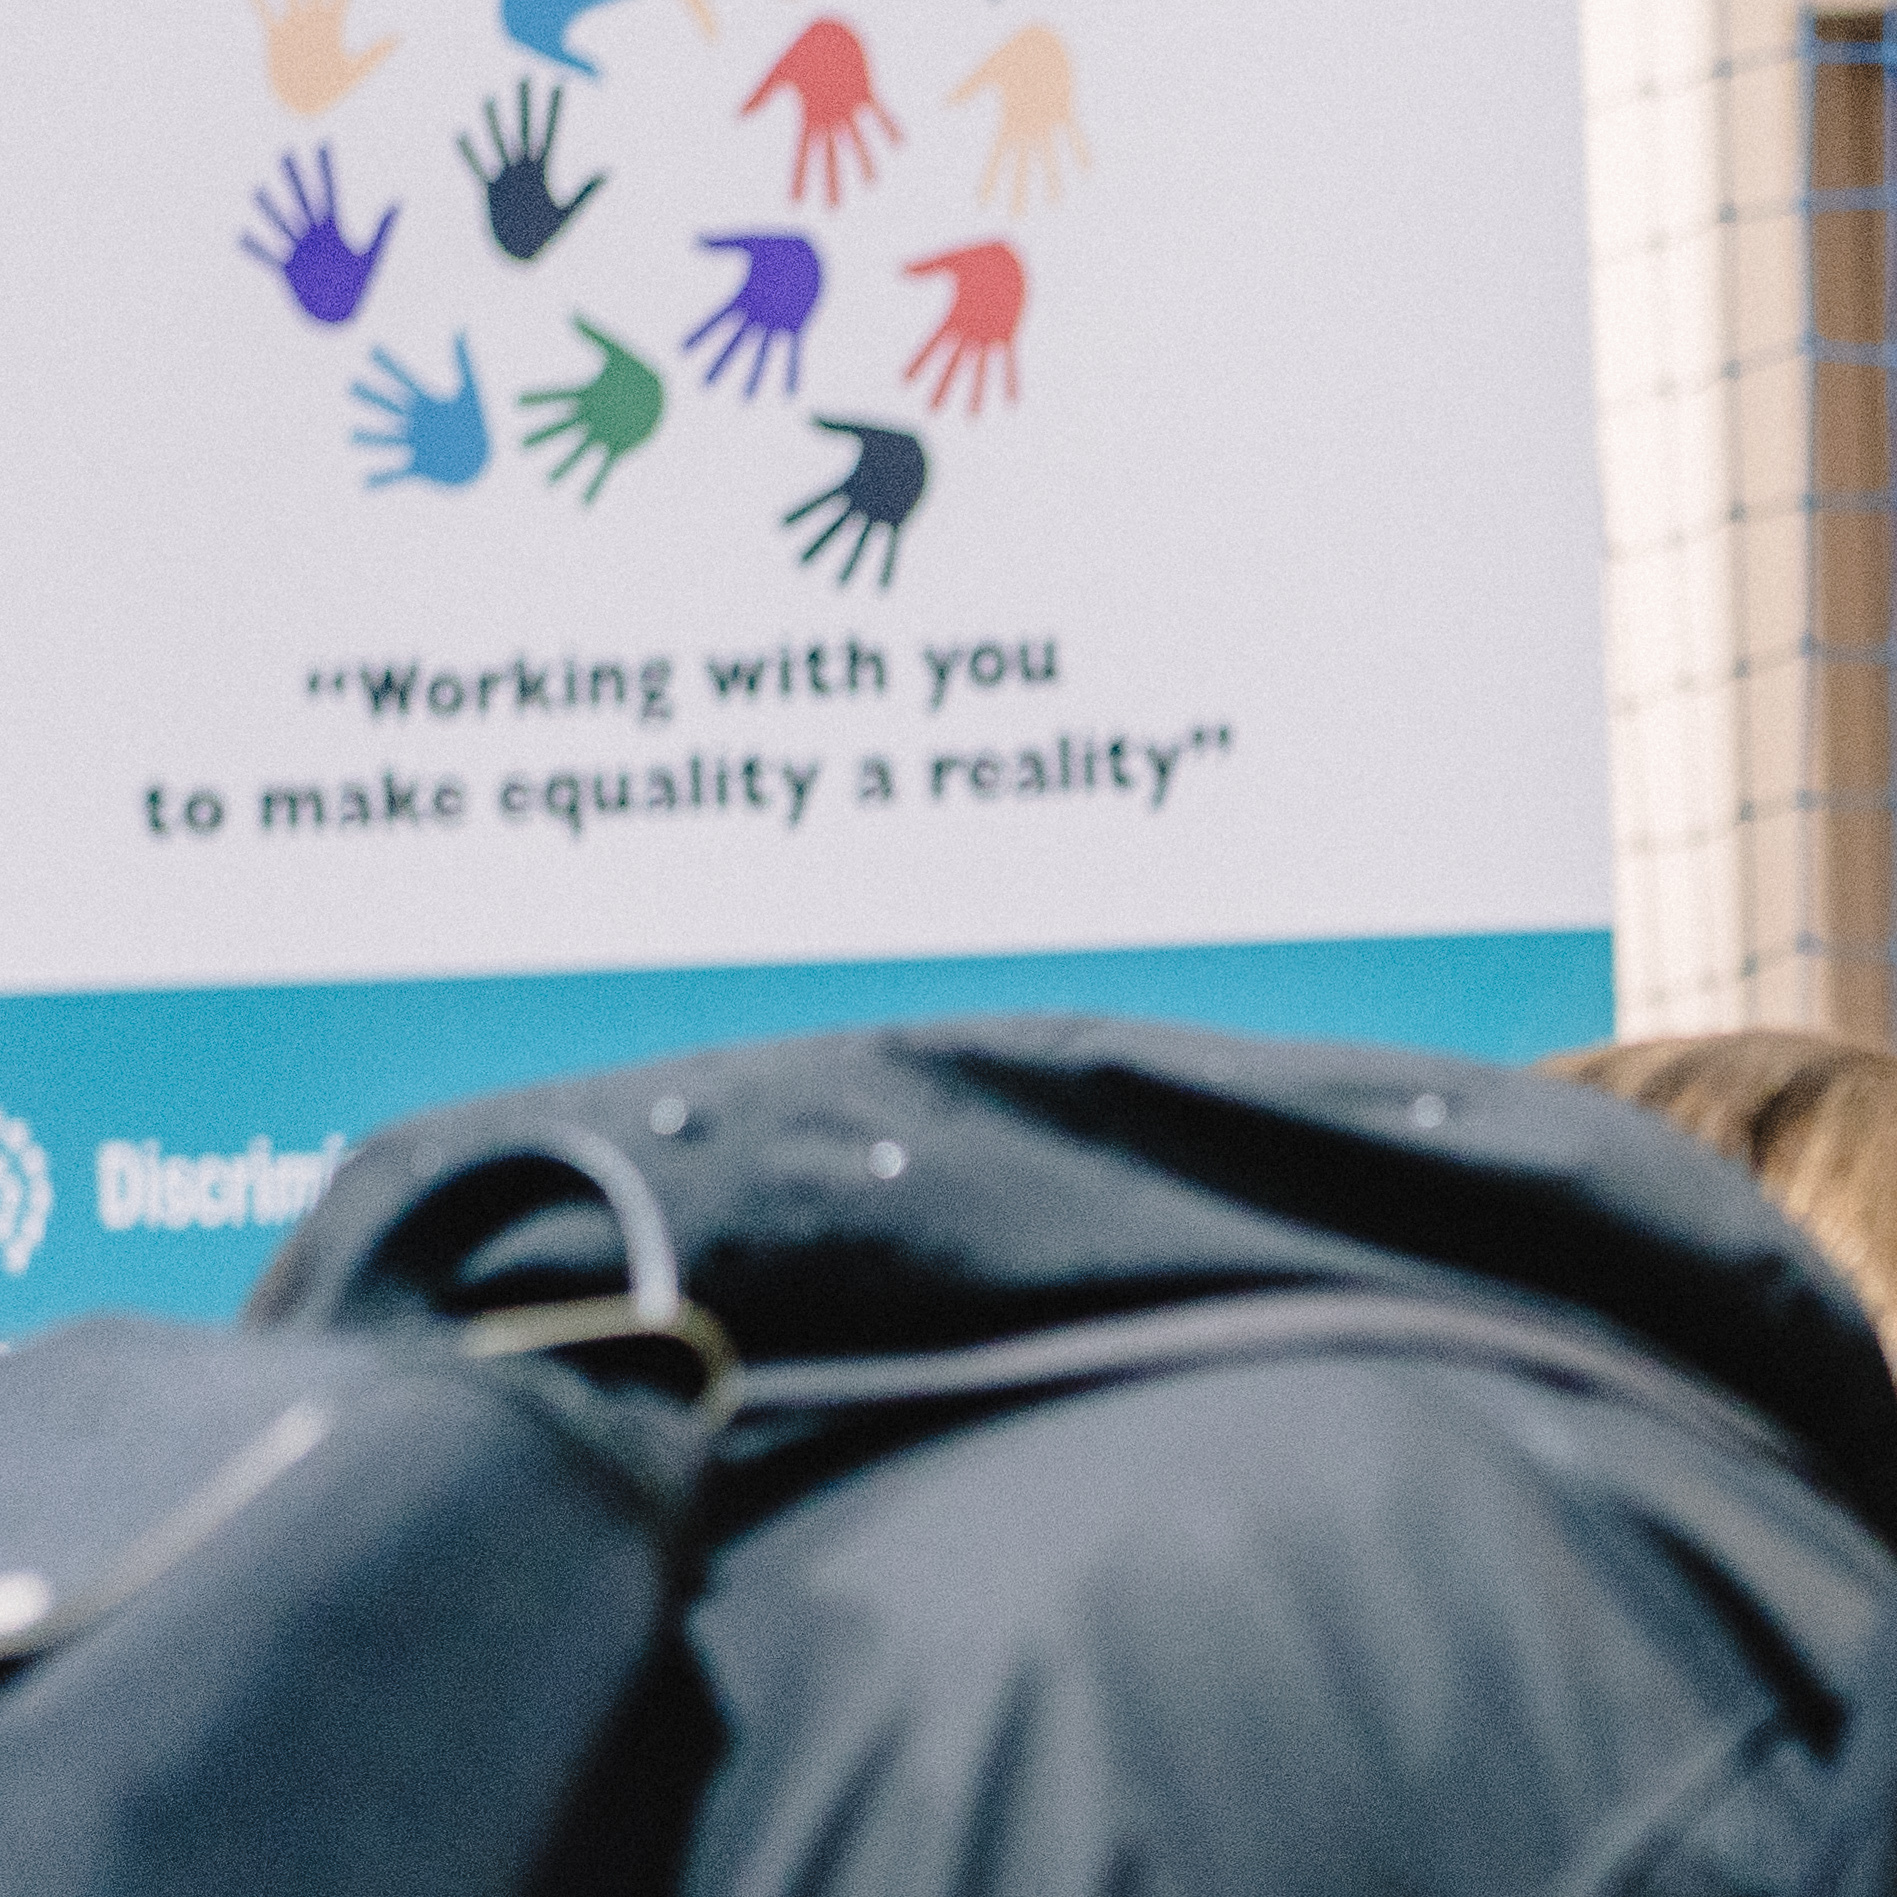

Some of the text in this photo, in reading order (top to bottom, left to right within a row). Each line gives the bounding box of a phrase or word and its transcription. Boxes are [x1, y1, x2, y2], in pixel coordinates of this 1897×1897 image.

[706, 633, 889, 698] with
[922, 637, 1058, 712] you
[144, 783, 225, 837] to
[260, 766, 466, 831] make
[499, 752, 821, 841] equality
[858, 752, 894, 802] a
